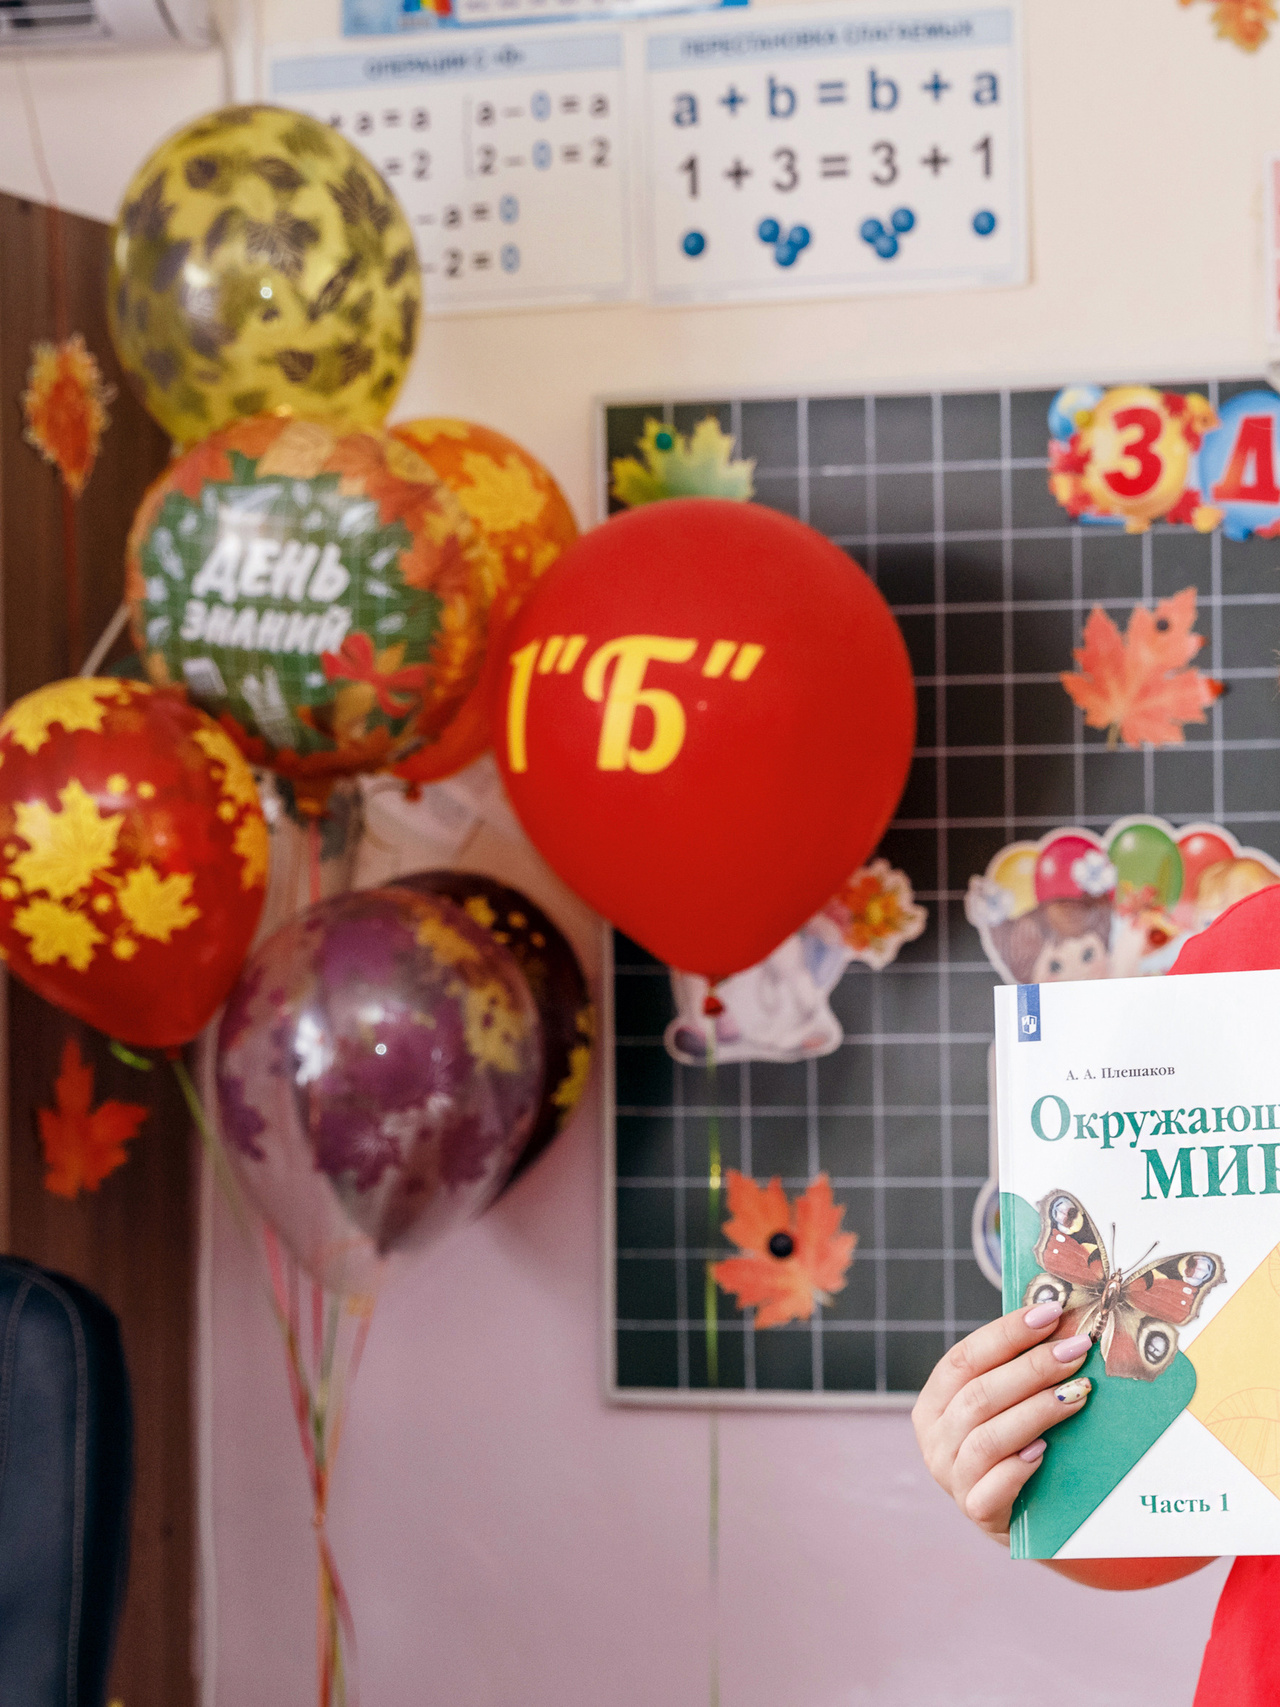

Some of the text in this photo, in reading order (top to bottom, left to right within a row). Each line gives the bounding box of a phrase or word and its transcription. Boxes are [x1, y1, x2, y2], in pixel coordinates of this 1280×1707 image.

[191, 532, 350, 604] ДЕНЬ
[1066, 1066, 1176, 1081] А. А. Плешаков
[1139, 1492, 1230, 1514] Часть 1
